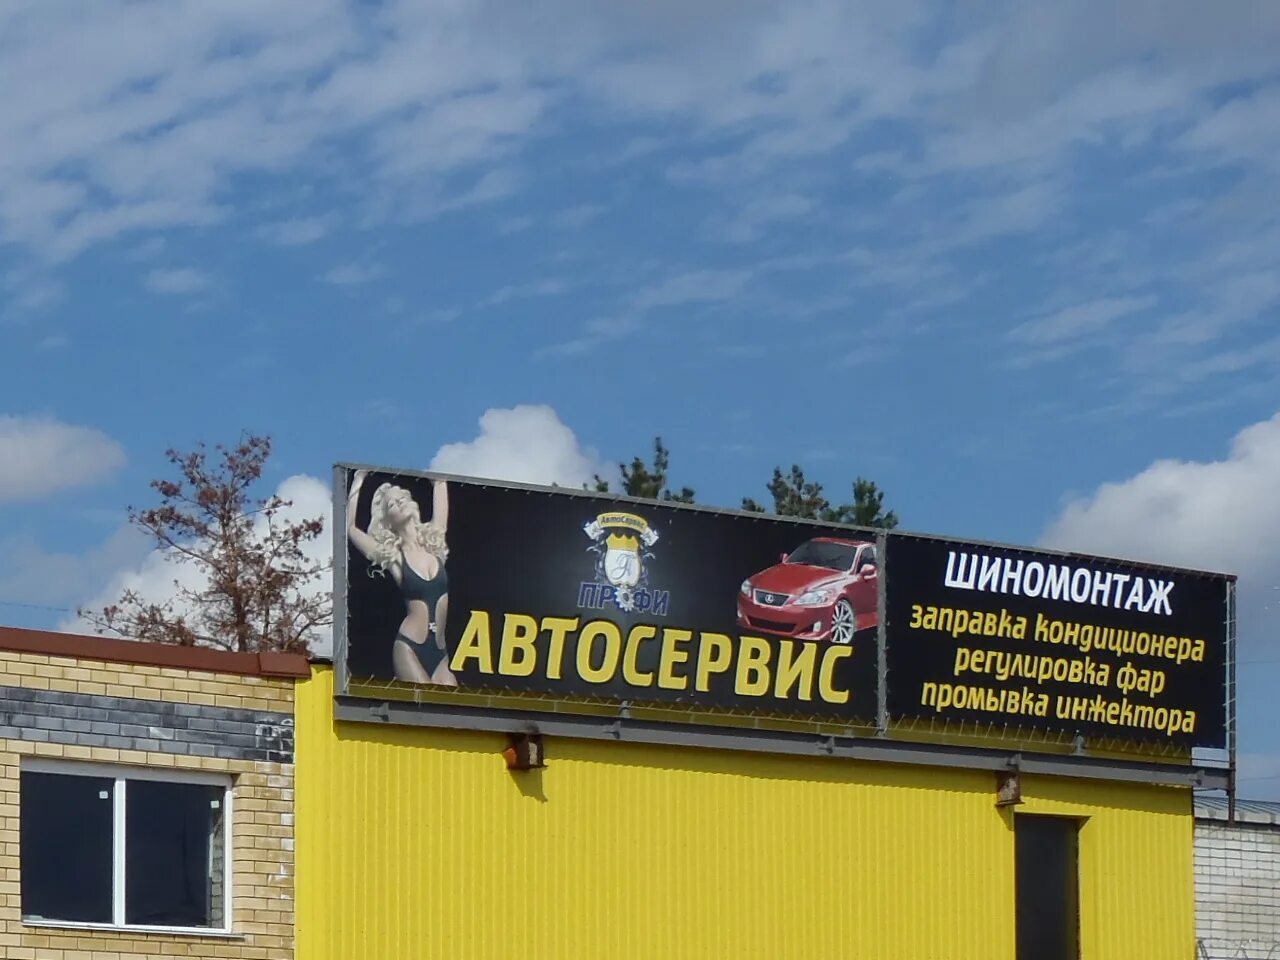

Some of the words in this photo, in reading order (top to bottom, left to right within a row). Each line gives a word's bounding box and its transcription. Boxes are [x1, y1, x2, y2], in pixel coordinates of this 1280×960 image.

[944, 551, 1175, 615] ШИНОМОНТАЖ
[449, 610, 853, 703] АВТОСЕРВИС
[909, 604, 1027, 639] заправка
[1034, 613, 1206, 664] кондиционера
[954, 647, 1110, 687] регулировка
[1116, 662, 1166, 697] фар
[921, 681, 1049, 717] промывка
[1055, 694, 1196, 736] инжектора
